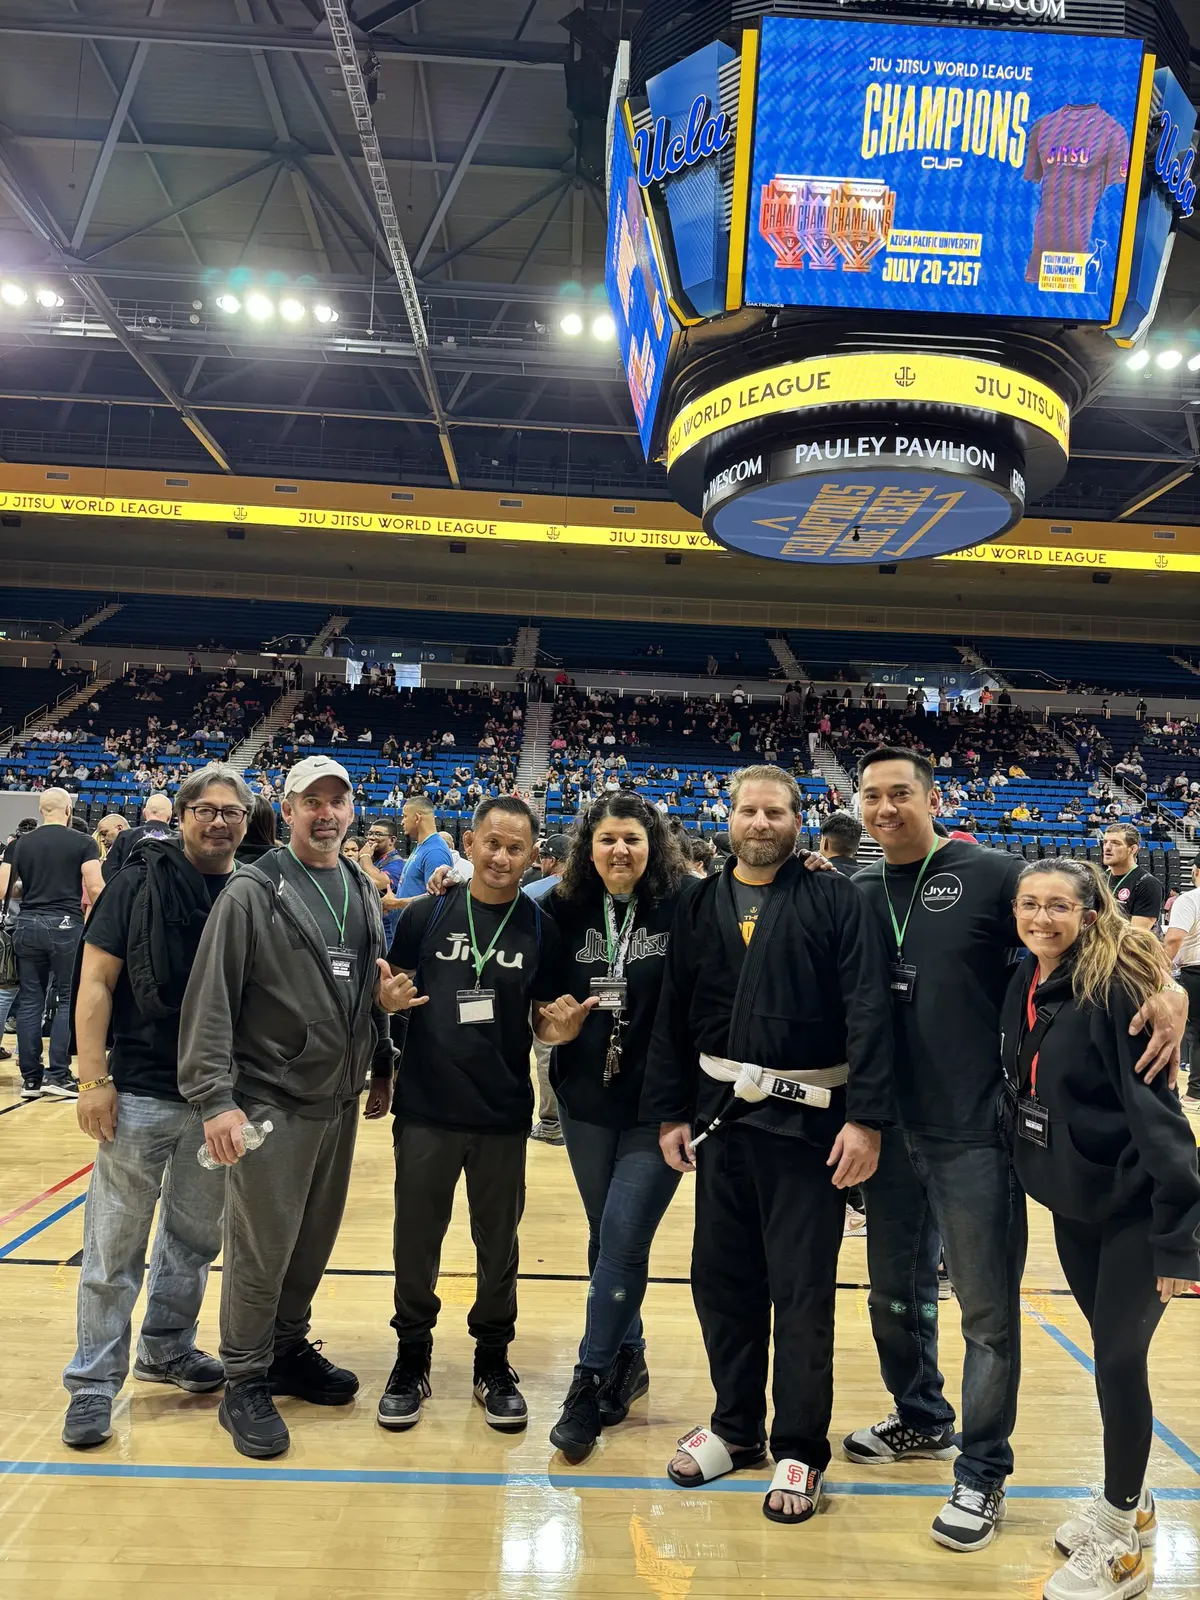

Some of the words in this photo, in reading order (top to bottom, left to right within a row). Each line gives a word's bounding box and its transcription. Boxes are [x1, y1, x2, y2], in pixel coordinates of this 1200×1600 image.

[869, 57, 892, 73] JIU
[895, 58, 931, 75] JITSU
[934, 61, 979, 77] WORLD
[982, 64, 1033, 81] LEAGUE
[861, 83, 1030, 169] CHAMPIONS
[921, 156, 963, 170] CUP
[763, 202, 796, 231] CHAM
[798, 204, 829, 232] CHAM
[831, 206, 892, 237] CHAMPIONS
[890, 234, 911, 246] AZUSA
[913, 235, 937, 248] PACIFIC
[939, 236, 980, 250] UNIVERSITY
[882, 257, 920, 283] JULY
[921, 259, 981, 286] 20-21ST
[1043, 264, 1082, 276] TOURNAMENT
[684, 397, 732, 437] WORLD
[739, 371, 831, 408] LEAGUE
[975, 375, 1011, 400] JIU
[1017, 386, 1054, 420] JITSU
[795, 437, 886, 464] PAULEY
[895, 436, 995, 472] PAVILION
[710, 455, 763, 498] WESCOM
[13, 496, 55, 509] JITSU
[61, 498, 115, 512] WORLD
[121, 502, 182, 516] LEAGUE
[780, 483, 876, 556] CHAMPIONS
[858, 486, 937, 526] HERE
[299, 512, 326, 525] JIU
[331, 514, 372, 528] JITSU
[378, 517, 431, 531] WORLD
[437, 521, 497, 535] LEAGUE
[609, 531, 636, 543] JIU
[641, 532, 681, 545] JITSU
[686, 534, 715, 547] WO
[829, 528, 899, 558] MADE
[991, 547, 1043, 561] WORLD
[1048, 550, 1107, 564] LEAGUE
[626, 927, 670, 965] itsu
